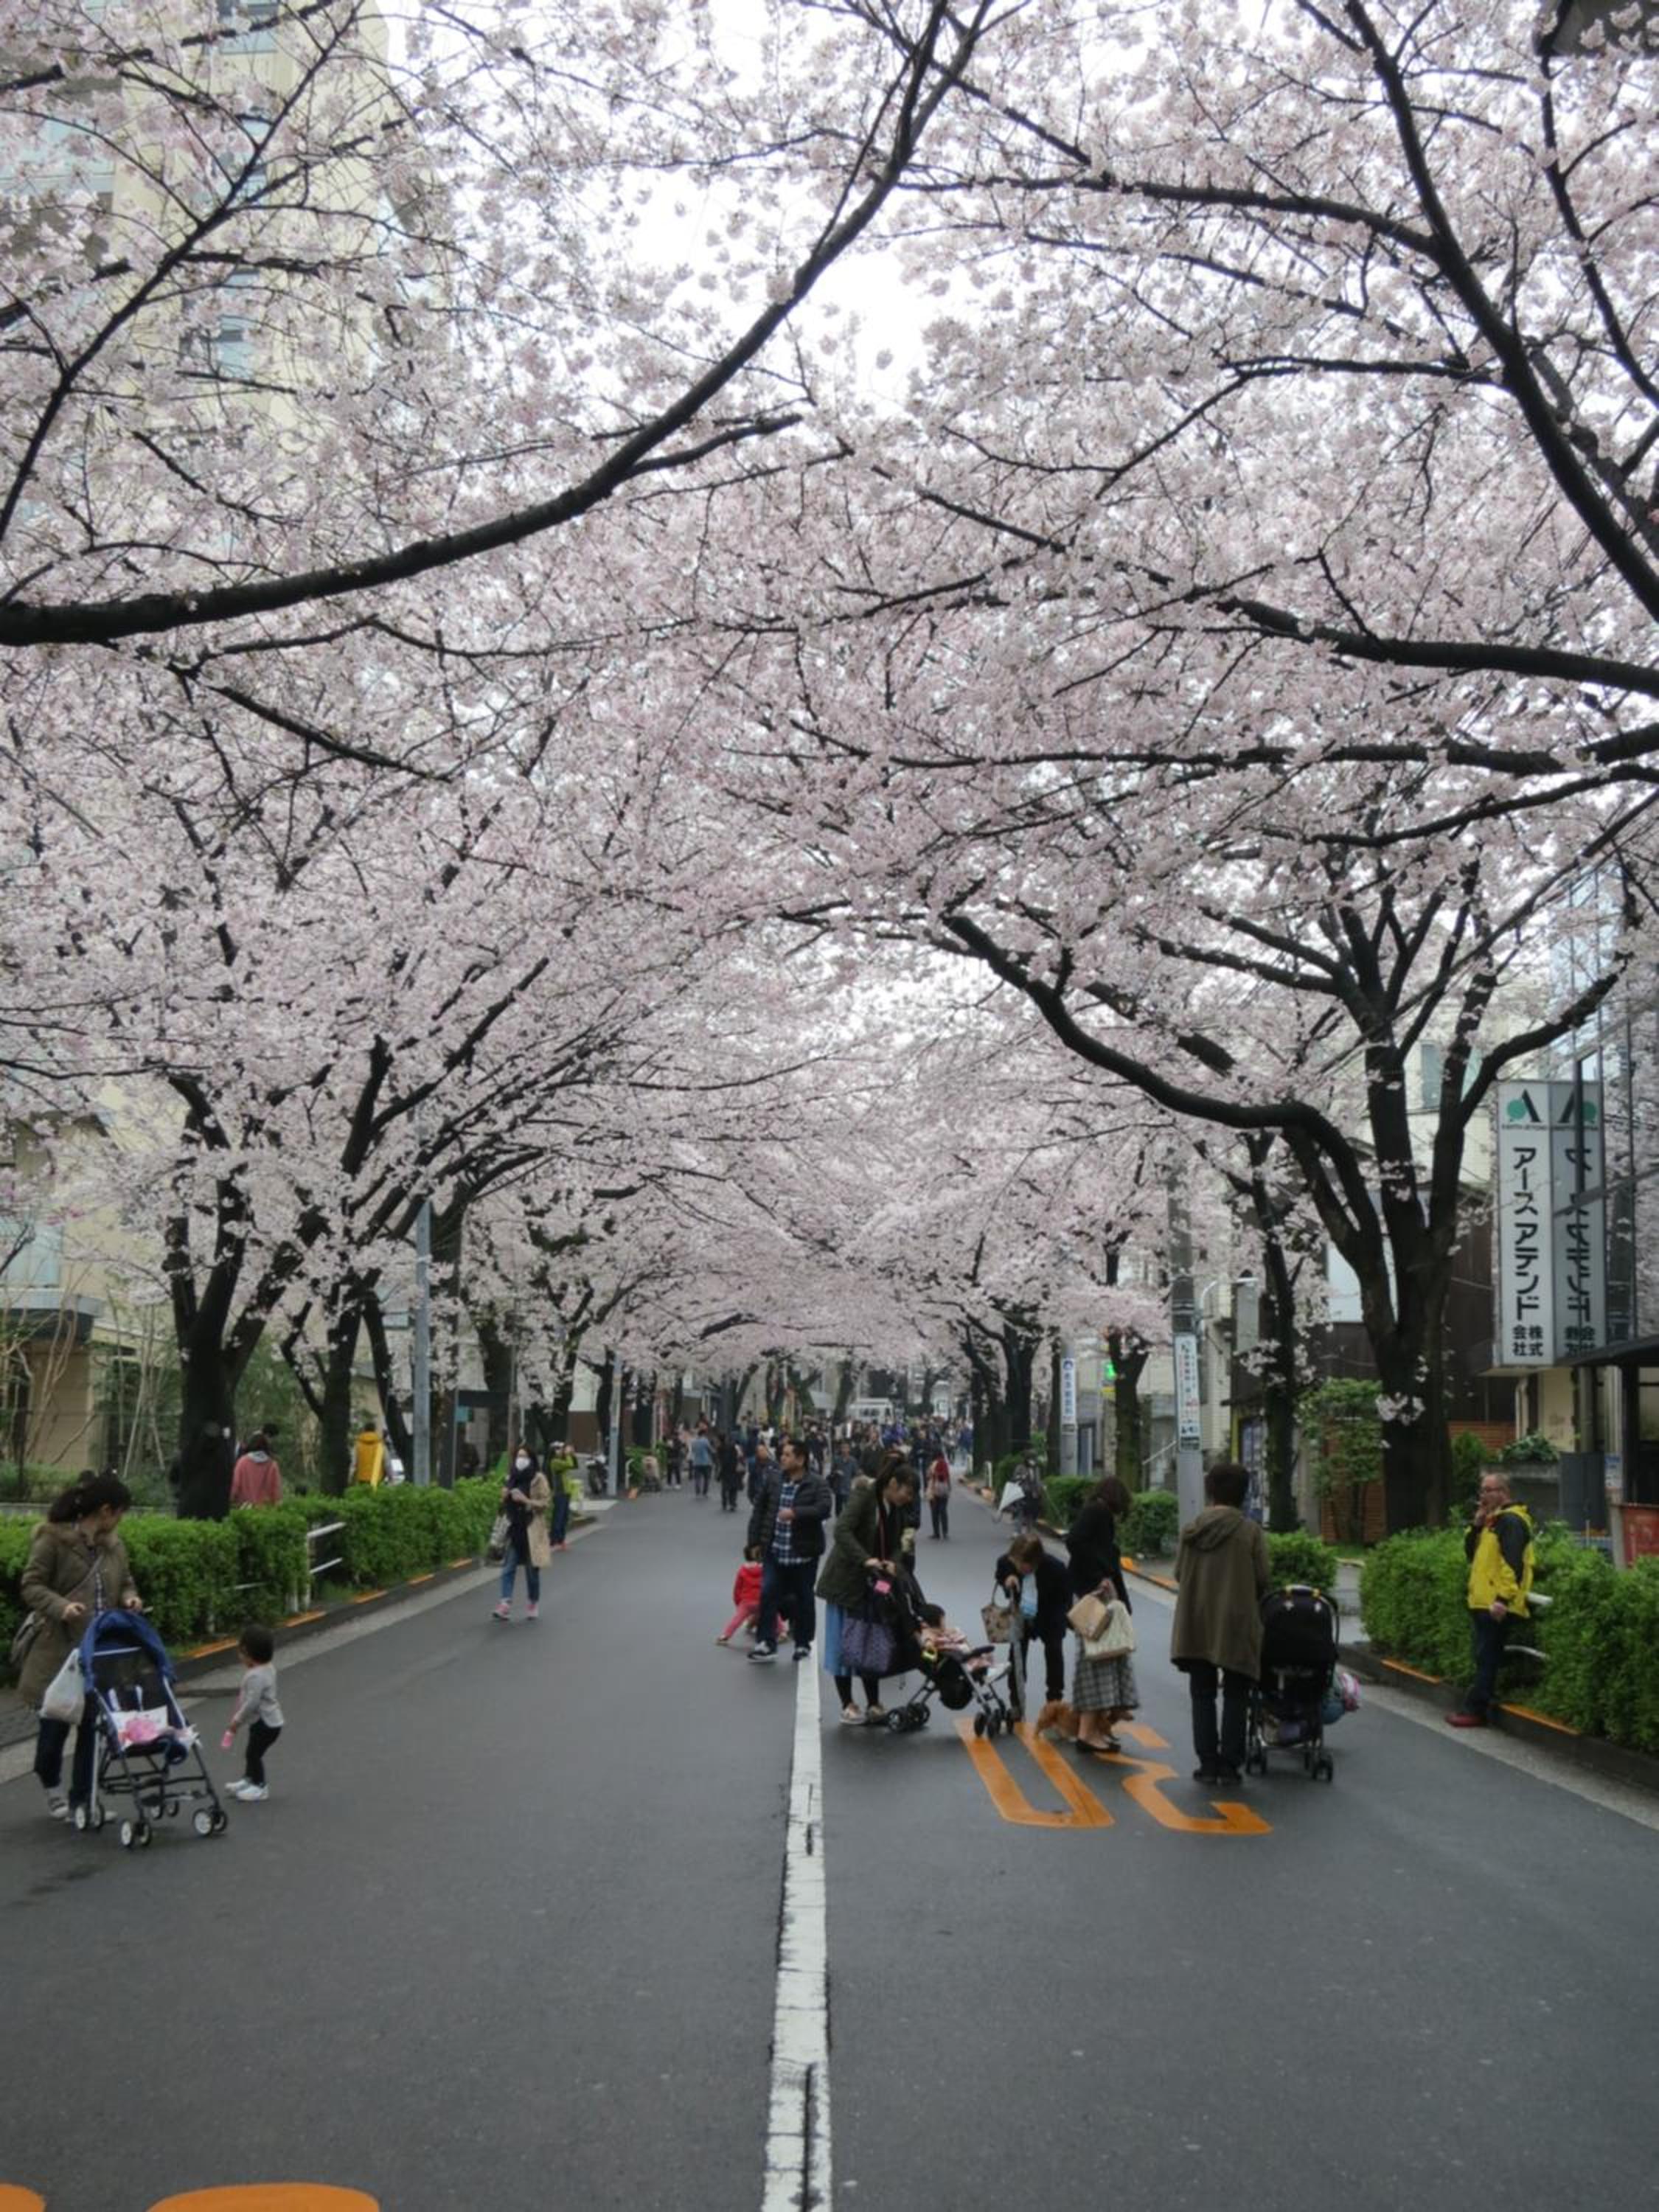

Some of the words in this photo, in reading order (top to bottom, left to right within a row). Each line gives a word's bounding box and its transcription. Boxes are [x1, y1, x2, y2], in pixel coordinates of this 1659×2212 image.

[1512, 1147, 1540, 1321] アースアテンド
